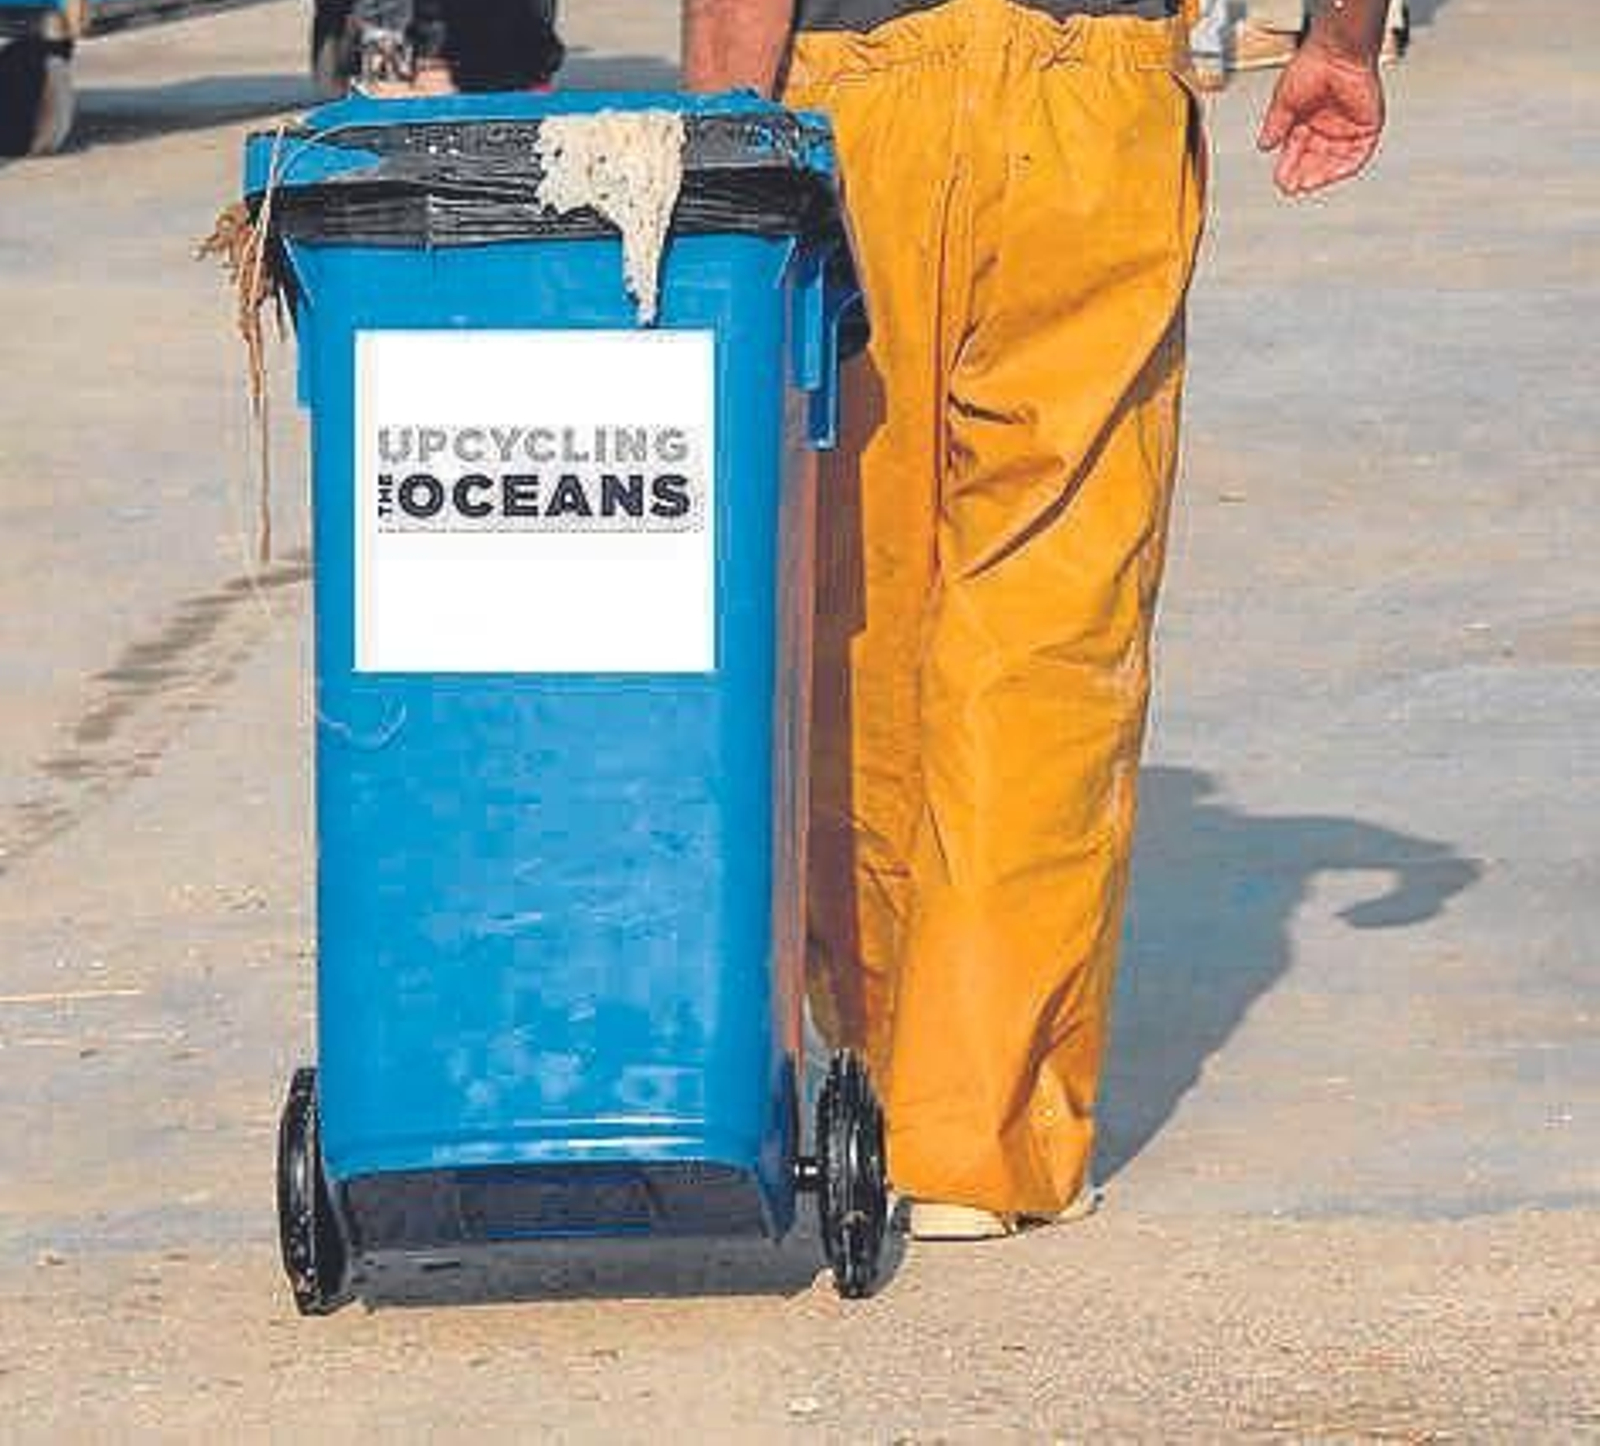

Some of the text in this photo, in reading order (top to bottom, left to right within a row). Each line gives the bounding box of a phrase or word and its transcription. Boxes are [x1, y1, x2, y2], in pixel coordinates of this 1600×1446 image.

[378, 426, 690, 463] UPCYCLING
[378, 474, 394, 518] THE
[398, 473, 691, 519] OCEANS
